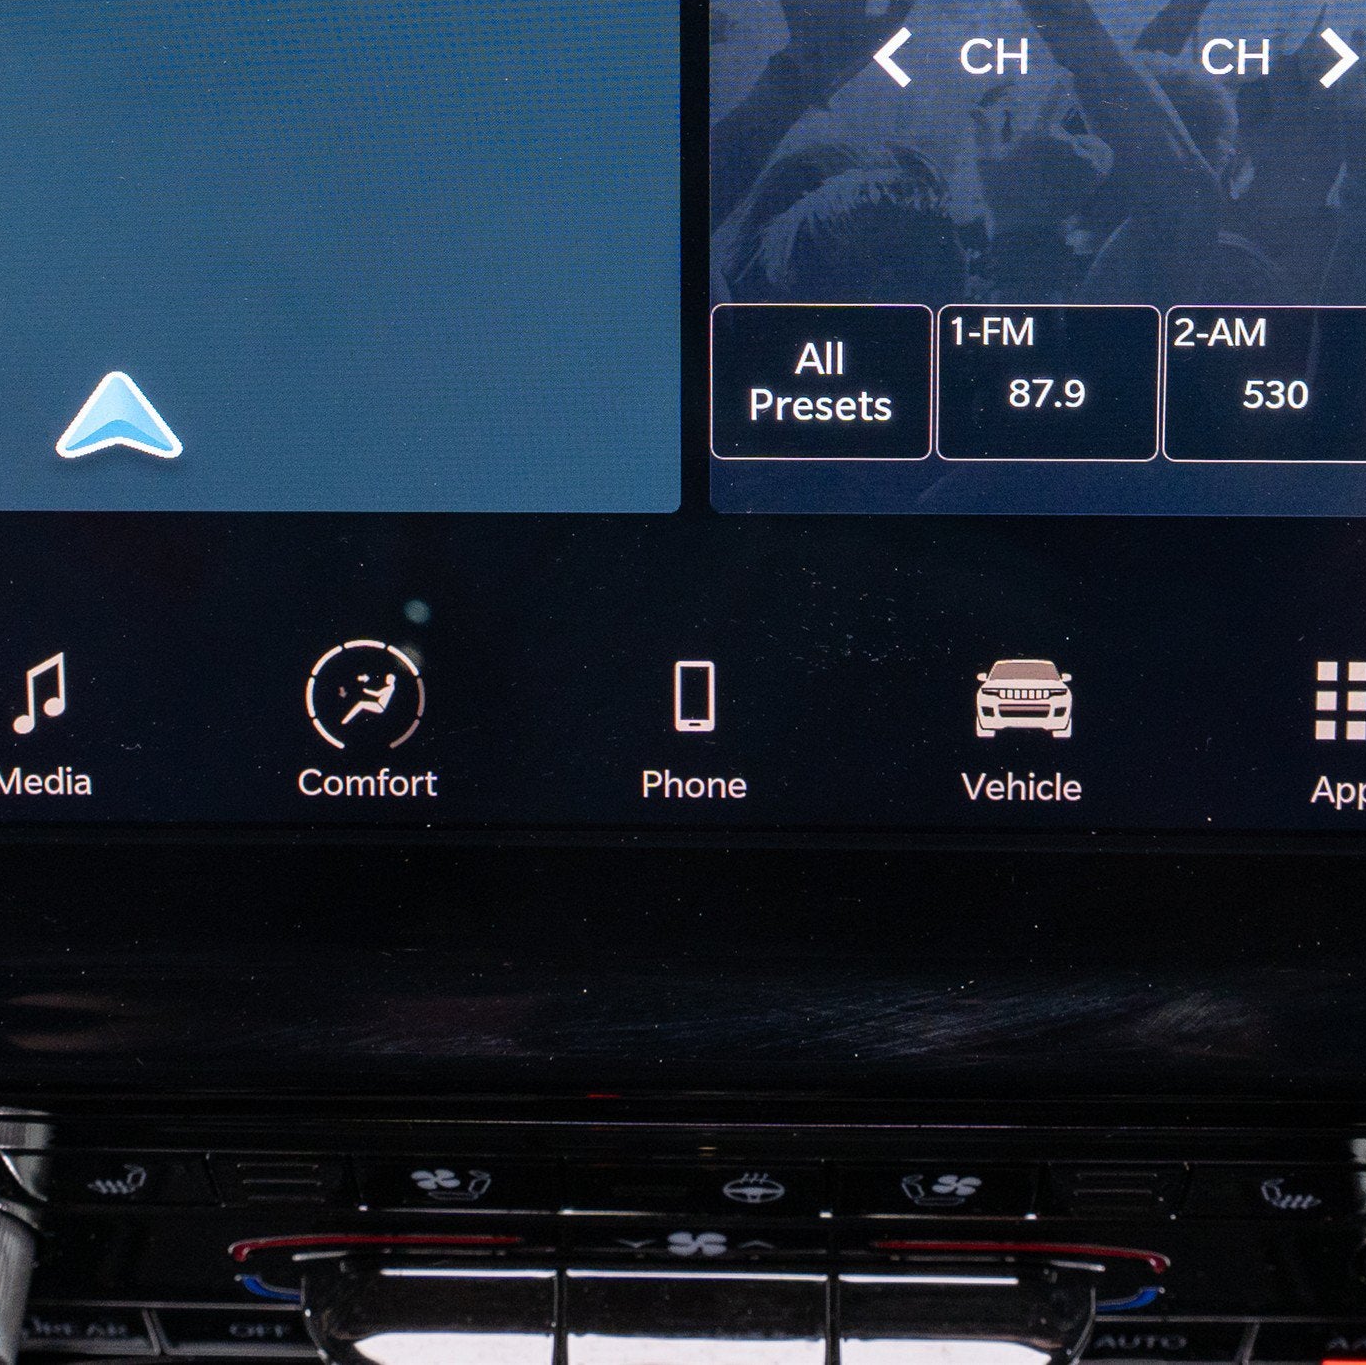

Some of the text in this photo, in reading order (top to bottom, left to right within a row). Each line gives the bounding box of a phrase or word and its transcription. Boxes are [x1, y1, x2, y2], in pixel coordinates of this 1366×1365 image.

[960, 37, 1029, 75] CH
[1201, 38, 1271, 76] CH
[951, 316, 1035, 346] 1-FM
[1173, 317, 1267, 347] 2-AM
[795, 341, 844, 376] All
[750, 388, 892, 422] Presets
[1008, 378, 1086, 408] 87.9
[1242, 380, 1309, 409] 530
[297, 767, 438, 798] Comfort
[642, 770, 748, 801] Phone
[961, 771, 1083, 802] Vehicle
[1093, 1333, 1187, 1350] AUTO
